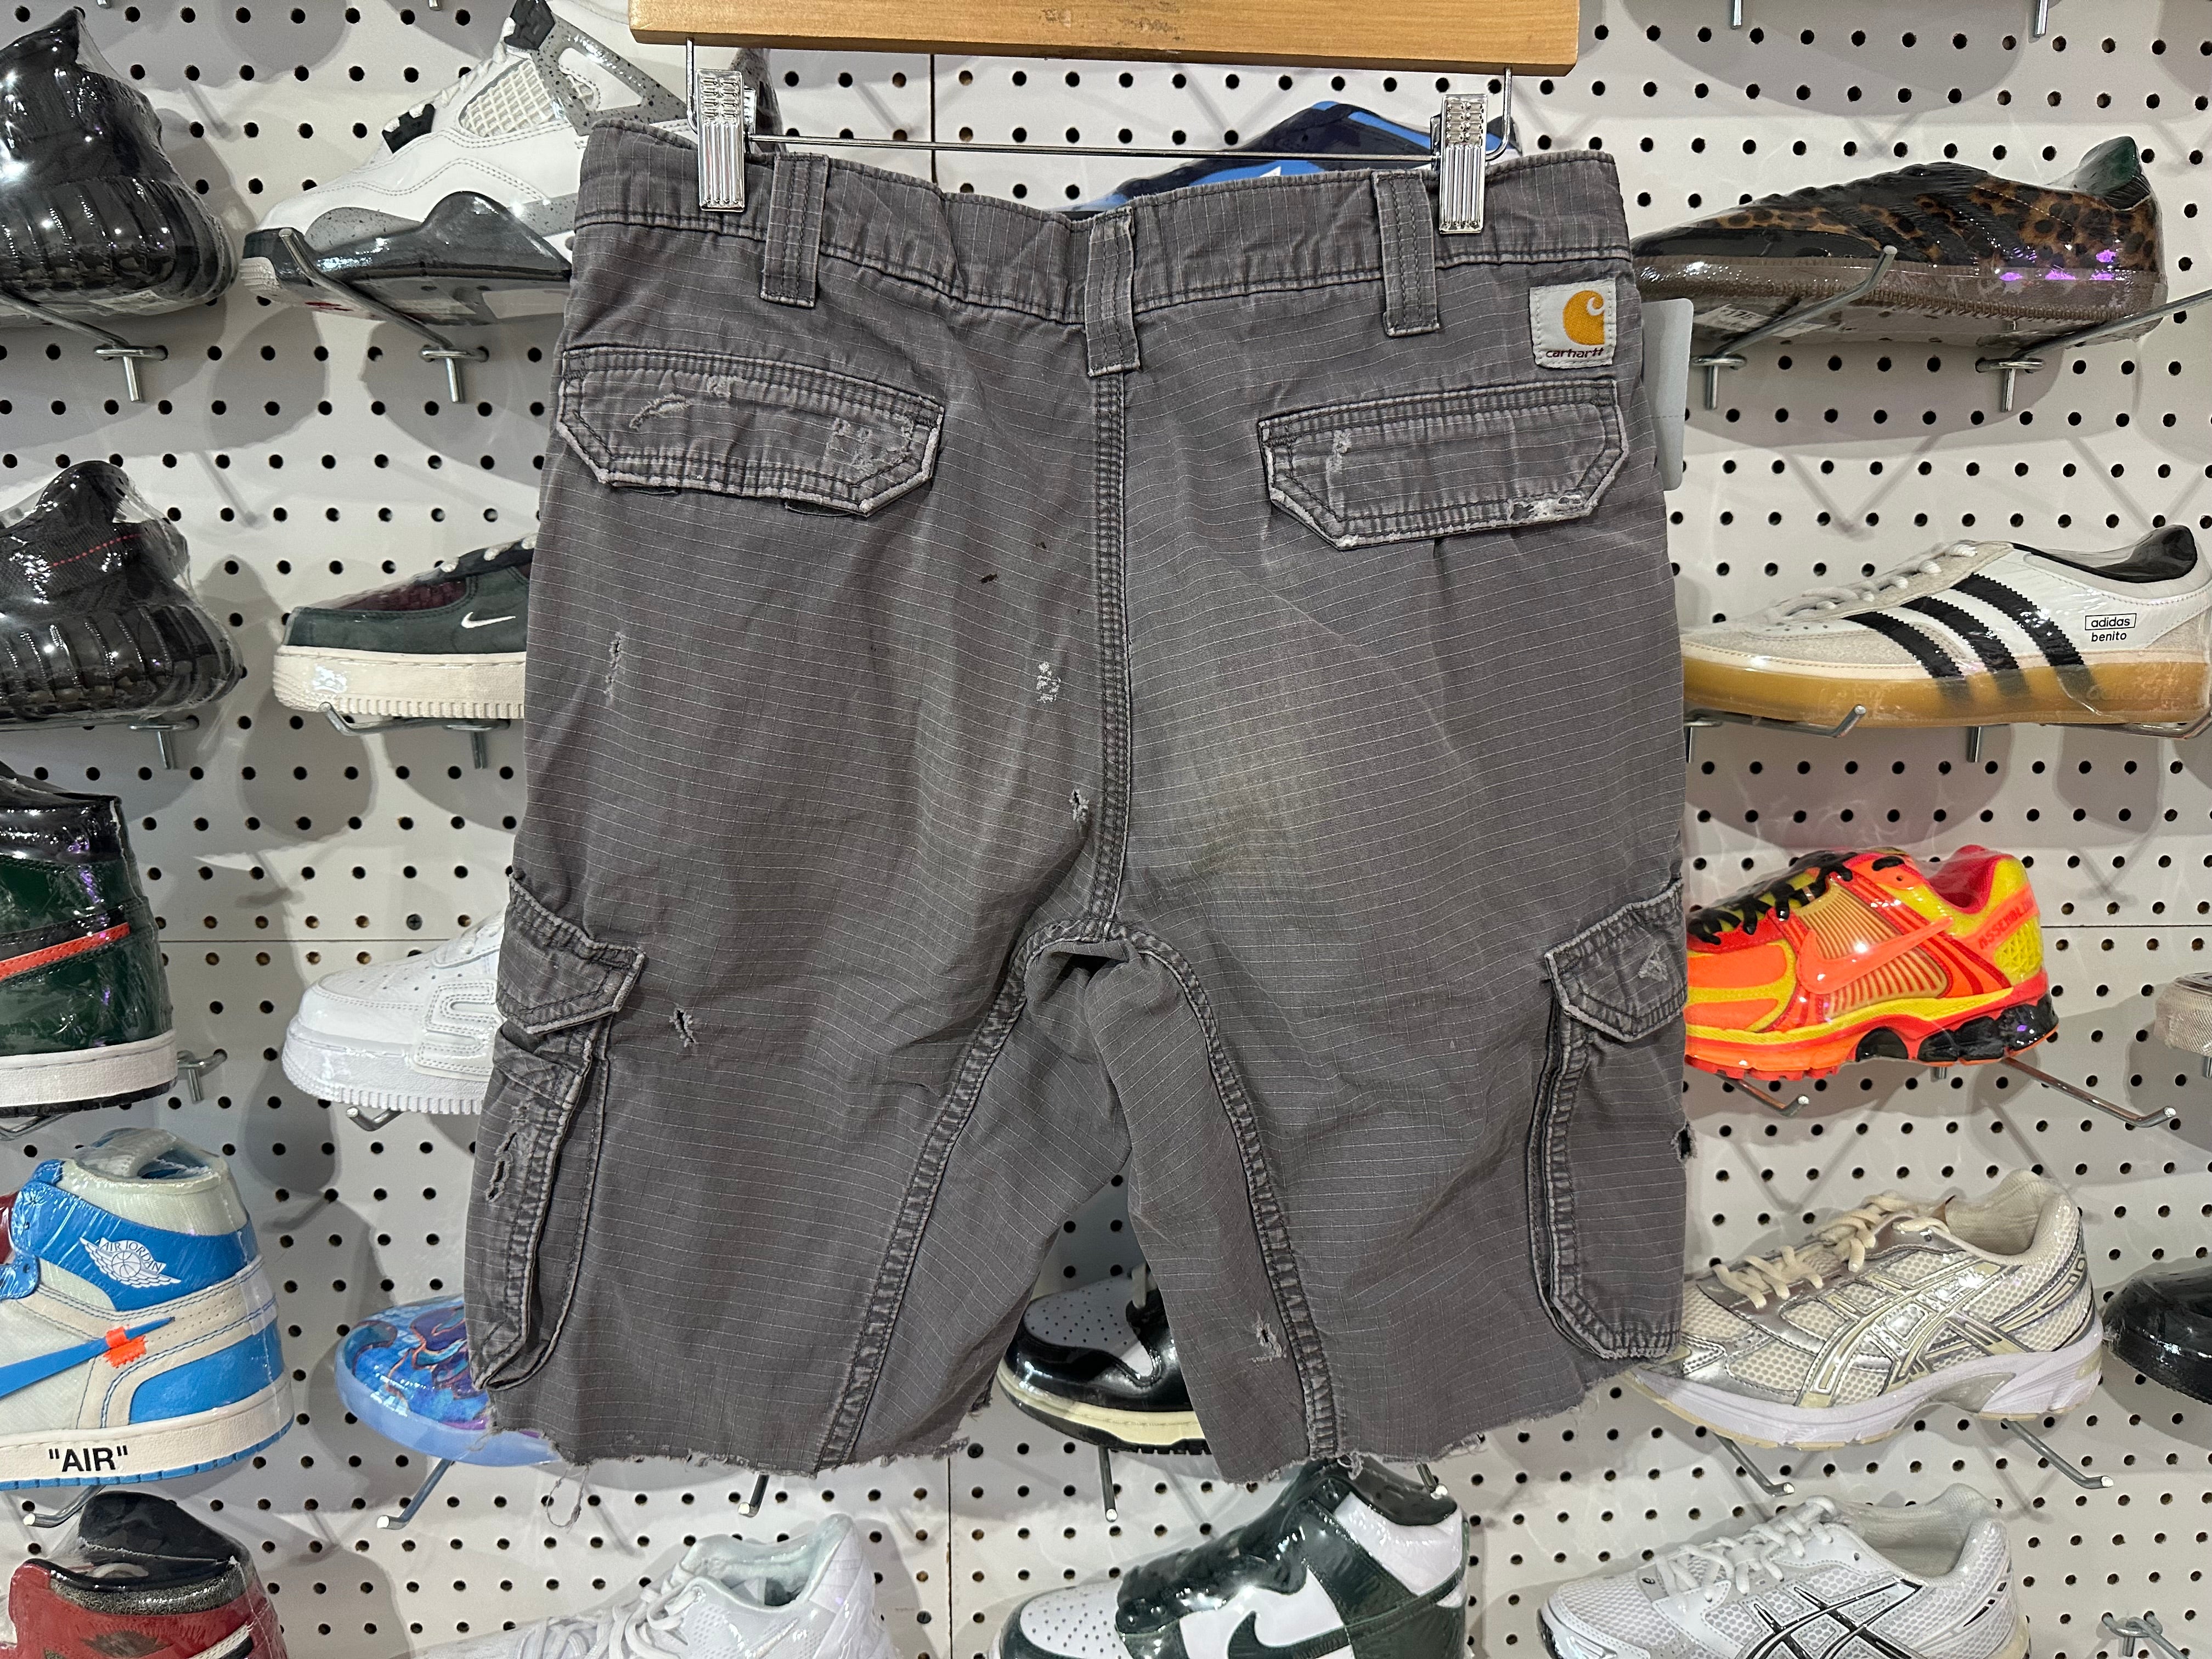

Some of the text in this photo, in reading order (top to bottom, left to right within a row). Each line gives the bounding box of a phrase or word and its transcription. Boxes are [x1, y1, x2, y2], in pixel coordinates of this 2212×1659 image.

[1545, 347, 1604, 358] carhartt
[2091, 617, 2130, 628] adidas
[2091, 630, 2127, 642] benito
[100, 1240, 162, 1272] AIR JORDAN
[49, 1445, 128, 1472] "AIR"
